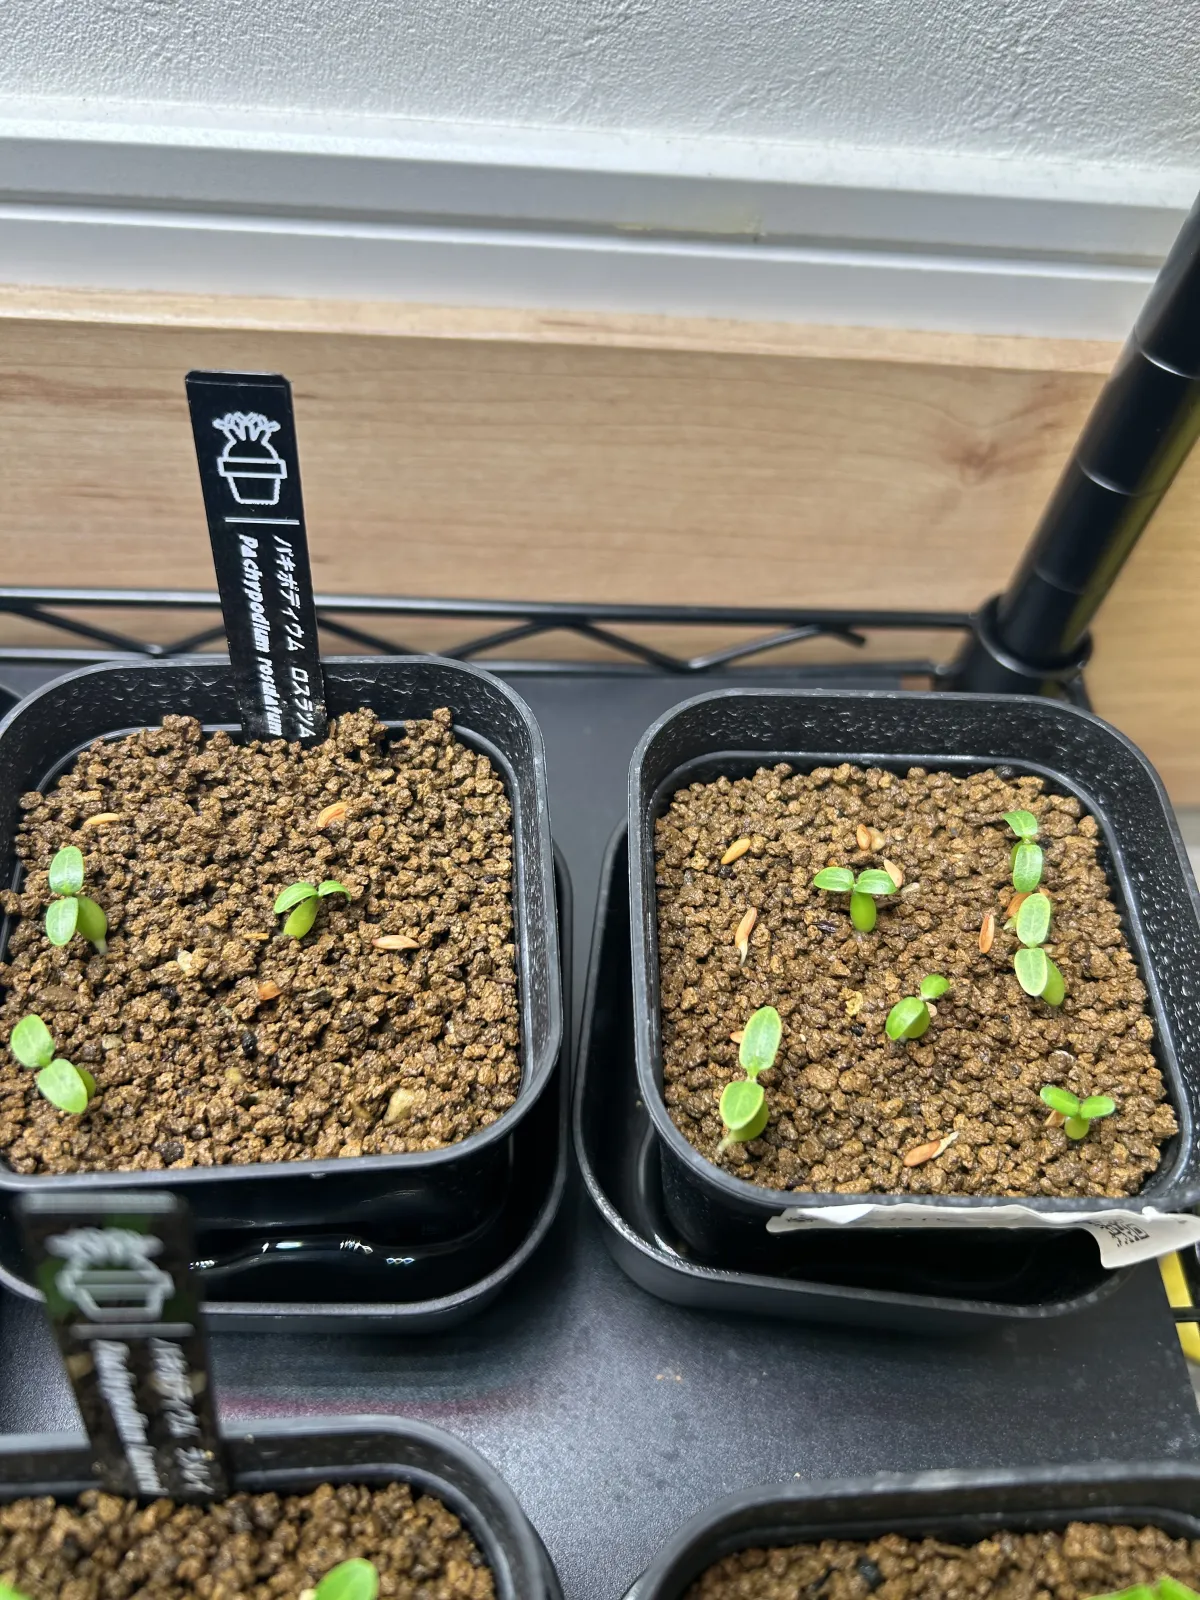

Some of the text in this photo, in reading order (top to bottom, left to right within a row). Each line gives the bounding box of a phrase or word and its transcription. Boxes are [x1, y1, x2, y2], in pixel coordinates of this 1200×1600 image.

[238, 534, 283, 736] Pachypodium rosulatum
[273, 535, 316, 738] パキポディウム ロスラツム
